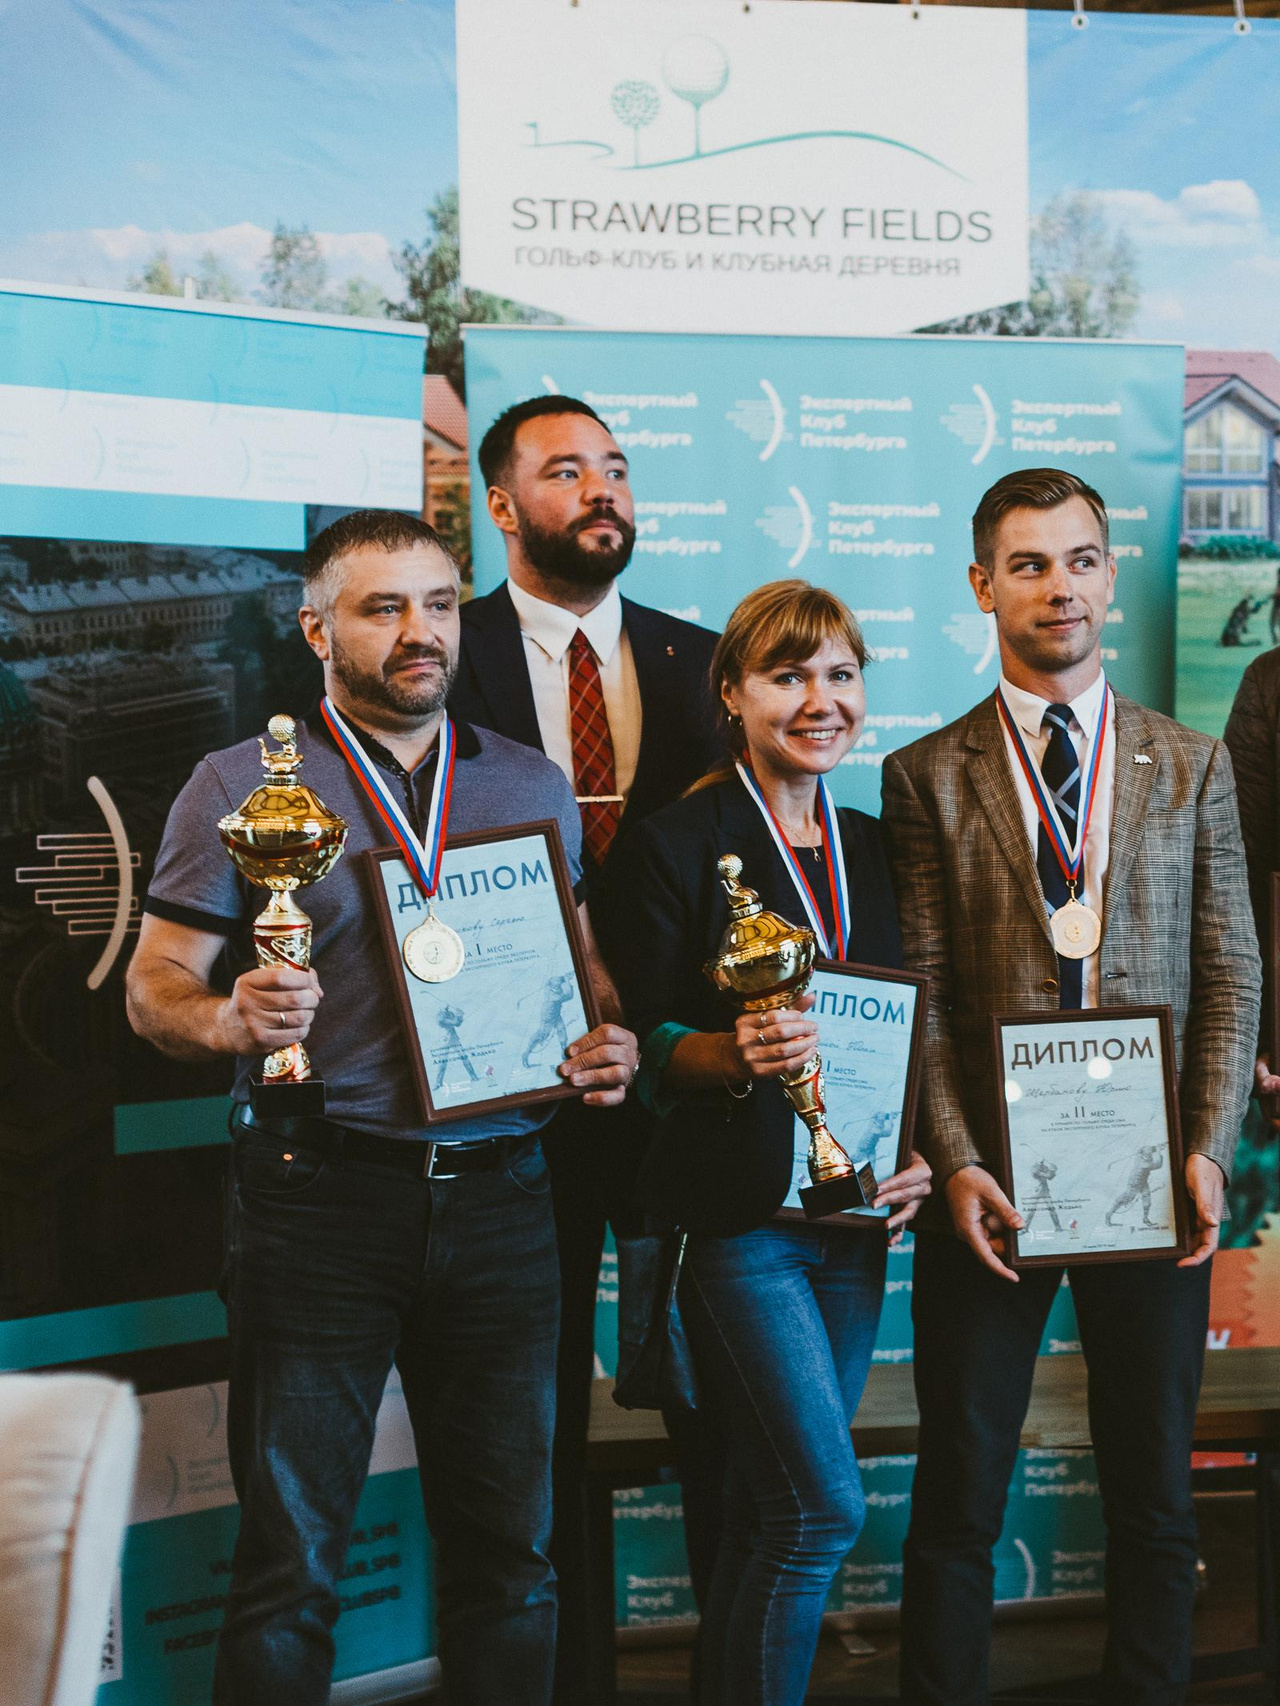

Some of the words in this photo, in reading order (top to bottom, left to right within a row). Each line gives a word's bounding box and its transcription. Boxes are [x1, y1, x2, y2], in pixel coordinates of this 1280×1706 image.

[511, 197, 827, 239] STRAWBERRY
[842, 206, 994, 244] FIELDS
[514, 245, 678, 272] ГОЛЬФ-КЛУБ
[686, 251, 704, 270] И
[711, 253, 832, 275] КЛУБНАЯ
[838, 256, 962, 281] ДЕРЕВНЯ
[800, 395, 913, 413] Экспертный
[1011, 399, 1122, 417] Экспертный
[800, 414, 847, 431] Клуб
[1011, 418, 1058, 435] Клуб
[800, 433, 907, 451] Петербурга
[1011, 436, 1117, 455] Петербурга
[828, 502, 941, 519] Экспертный
[828, 520, 876, 537] Клуб
[828, 539, 935, 556] Петербурга
[487, 943, 514, 955] МЕСТО
[1012, 1036, 1155, 1071] ДИПЛОМ
[834, 1067, 857, 1076] МЕСТО
[1090, 1110, 1116, 1118] МЕСТО
